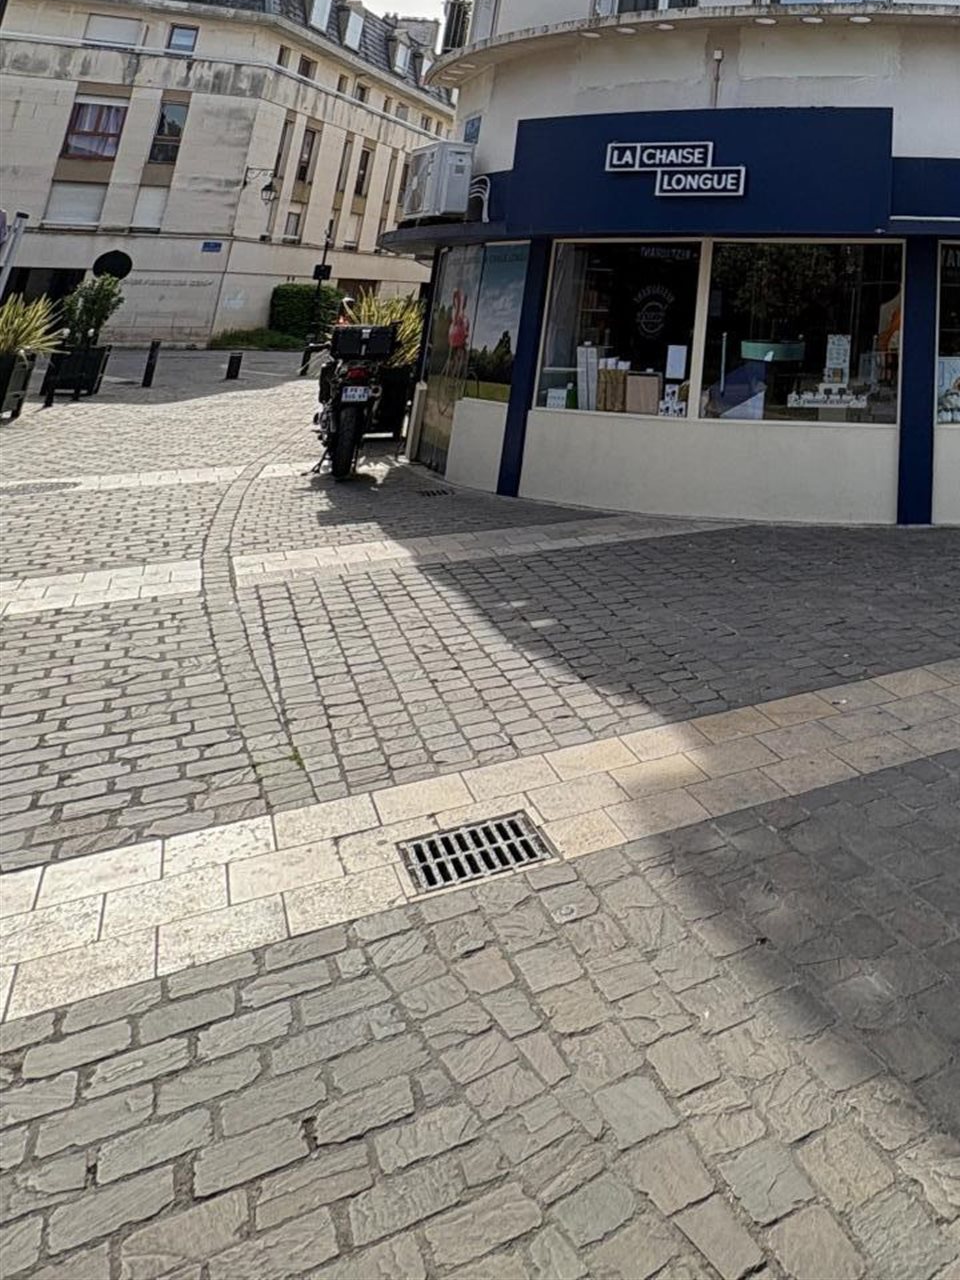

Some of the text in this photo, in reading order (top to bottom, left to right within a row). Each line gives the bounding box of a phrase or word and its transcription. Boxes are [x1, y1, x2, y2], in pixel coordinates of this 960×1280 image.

[612, 148, 705, 165] LA CHAISE
[662, 173, 738, 190] LONGUE
